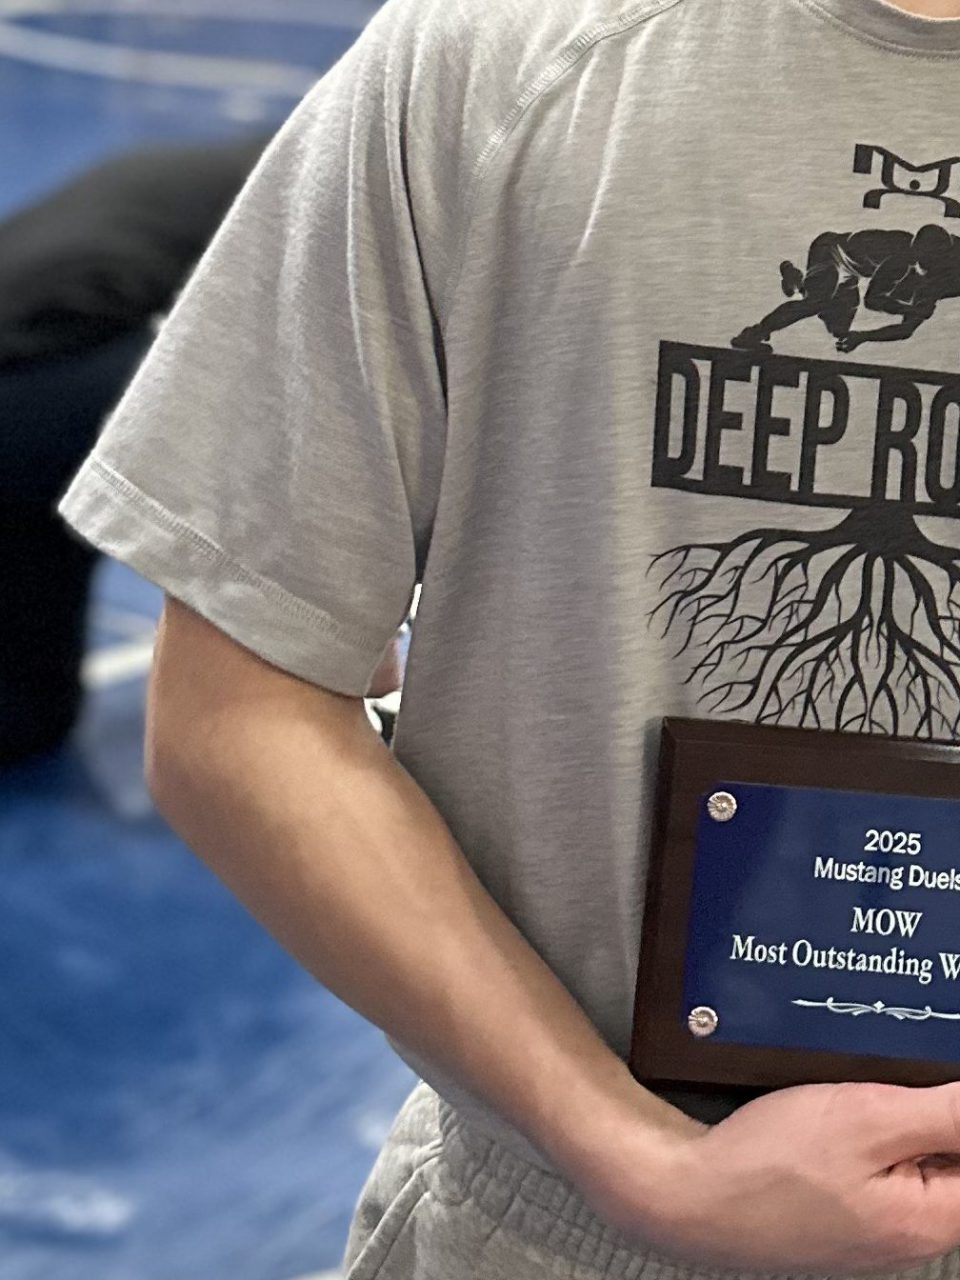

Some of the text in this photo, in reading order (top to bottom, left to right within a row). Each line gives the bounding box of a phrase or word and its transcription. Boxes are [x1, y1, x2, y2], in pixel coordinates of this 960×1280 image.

[654, 348, 850, 495] DEEP
[864, 829, 922, 855] 2025
[813, 857, 904, 890] Mustang
[851, 907, 923, 939] MOW
[730, 934, 788, 966] Most
[792, 939, 933, 985] Outstanding
